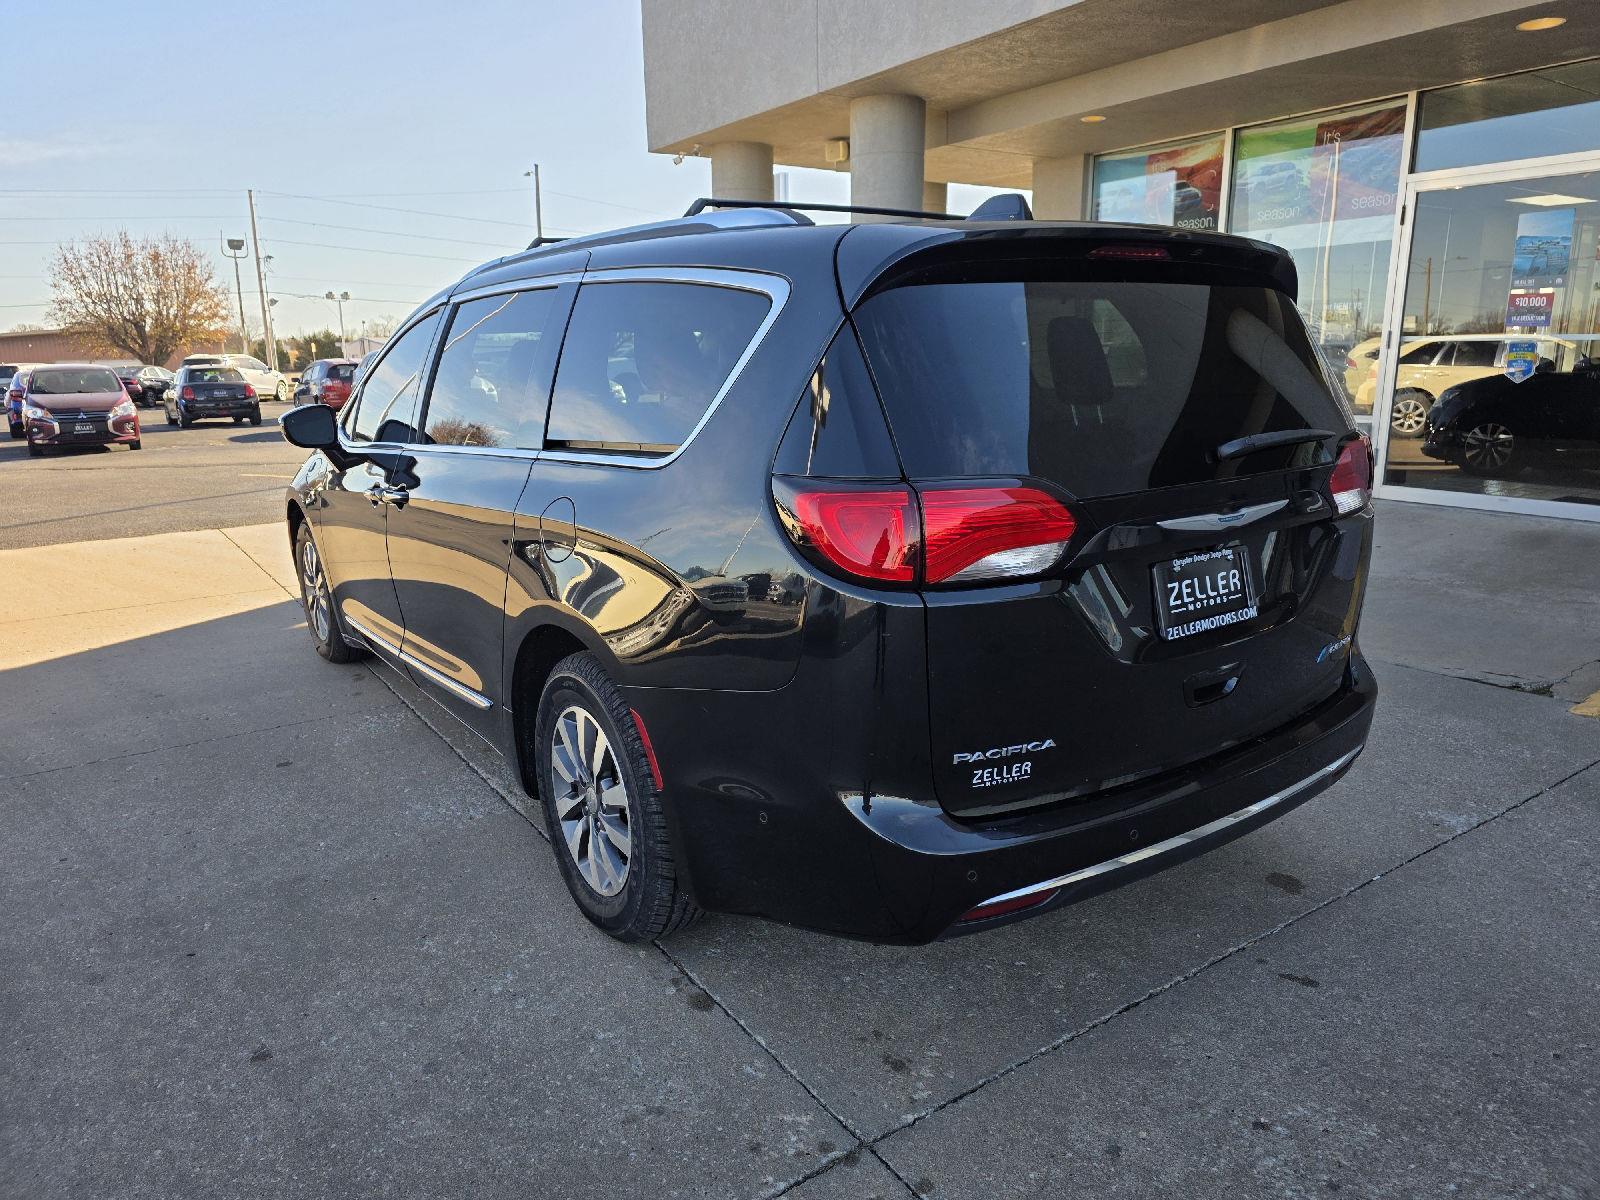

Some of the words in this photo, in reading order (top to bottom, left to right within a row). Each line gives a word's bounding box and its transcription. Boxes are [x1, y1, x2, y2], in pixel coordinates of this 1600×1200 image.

[1323, 130, 1341, 145] It's
[1177, 216, 1215, 229] season.
[1172, 556, 1193, 567] Chrysler
[1193, 553, 1210, 562] Dodge
[1167, 569, 1241, 606] ZELLER
[1187, 596, 1228, 611] MOTORS
[1167, 605, 1258, 640] ZELLERMOTORS.COM
[952, 739, 1057, 765] PACIFICA
[972, 761, 1032, 784] ZELLER
